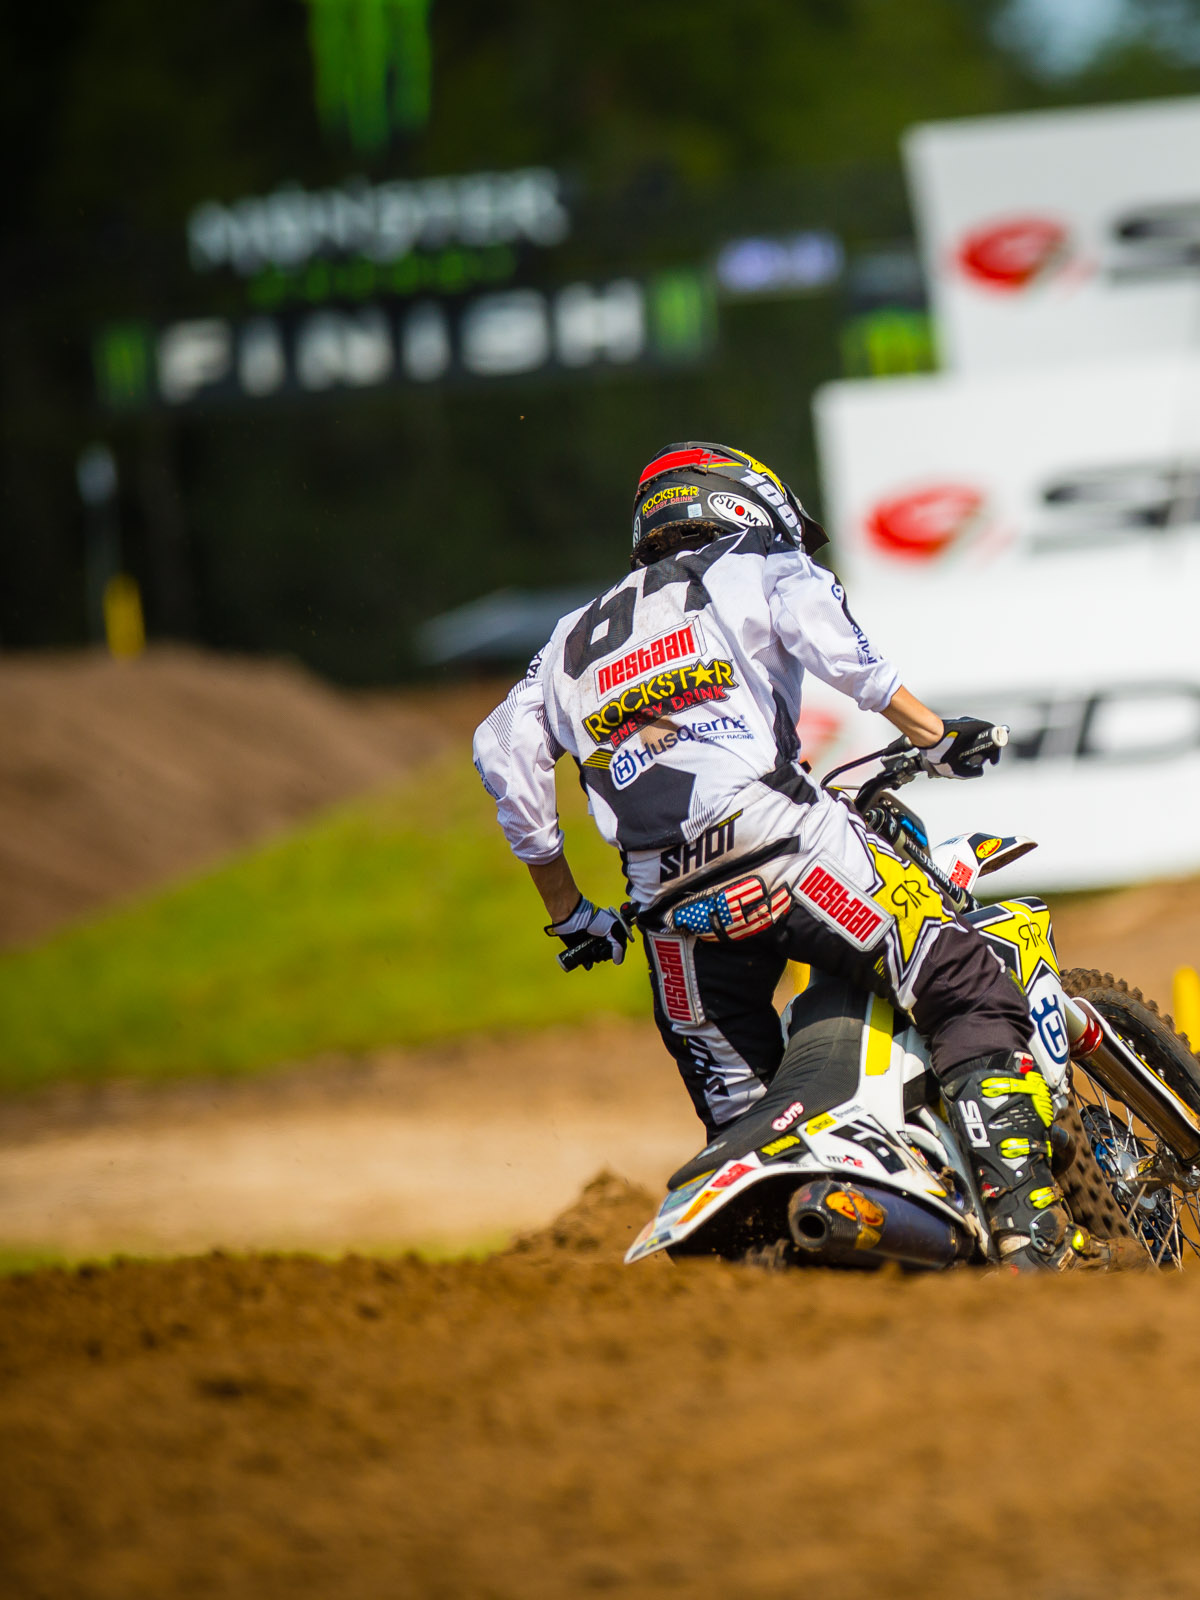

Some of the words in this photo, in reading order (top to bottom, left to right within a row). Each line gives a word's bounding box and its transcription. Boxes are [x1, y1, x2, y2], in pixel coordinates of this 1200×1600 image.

[157, 278, 644, 401] FINISH
[598, 626, 695, 695] nestaan
[585, 661, 734, 741] ROCKSTAR
[610, 703, 662, 747] ENERGY
[672, 686, 726, 711] DRINK
[799, 866, 882, 943] nestaan
[772, 1101, 804, 1131] GUTS
[958, 1100, 991, 1148] SIDI
